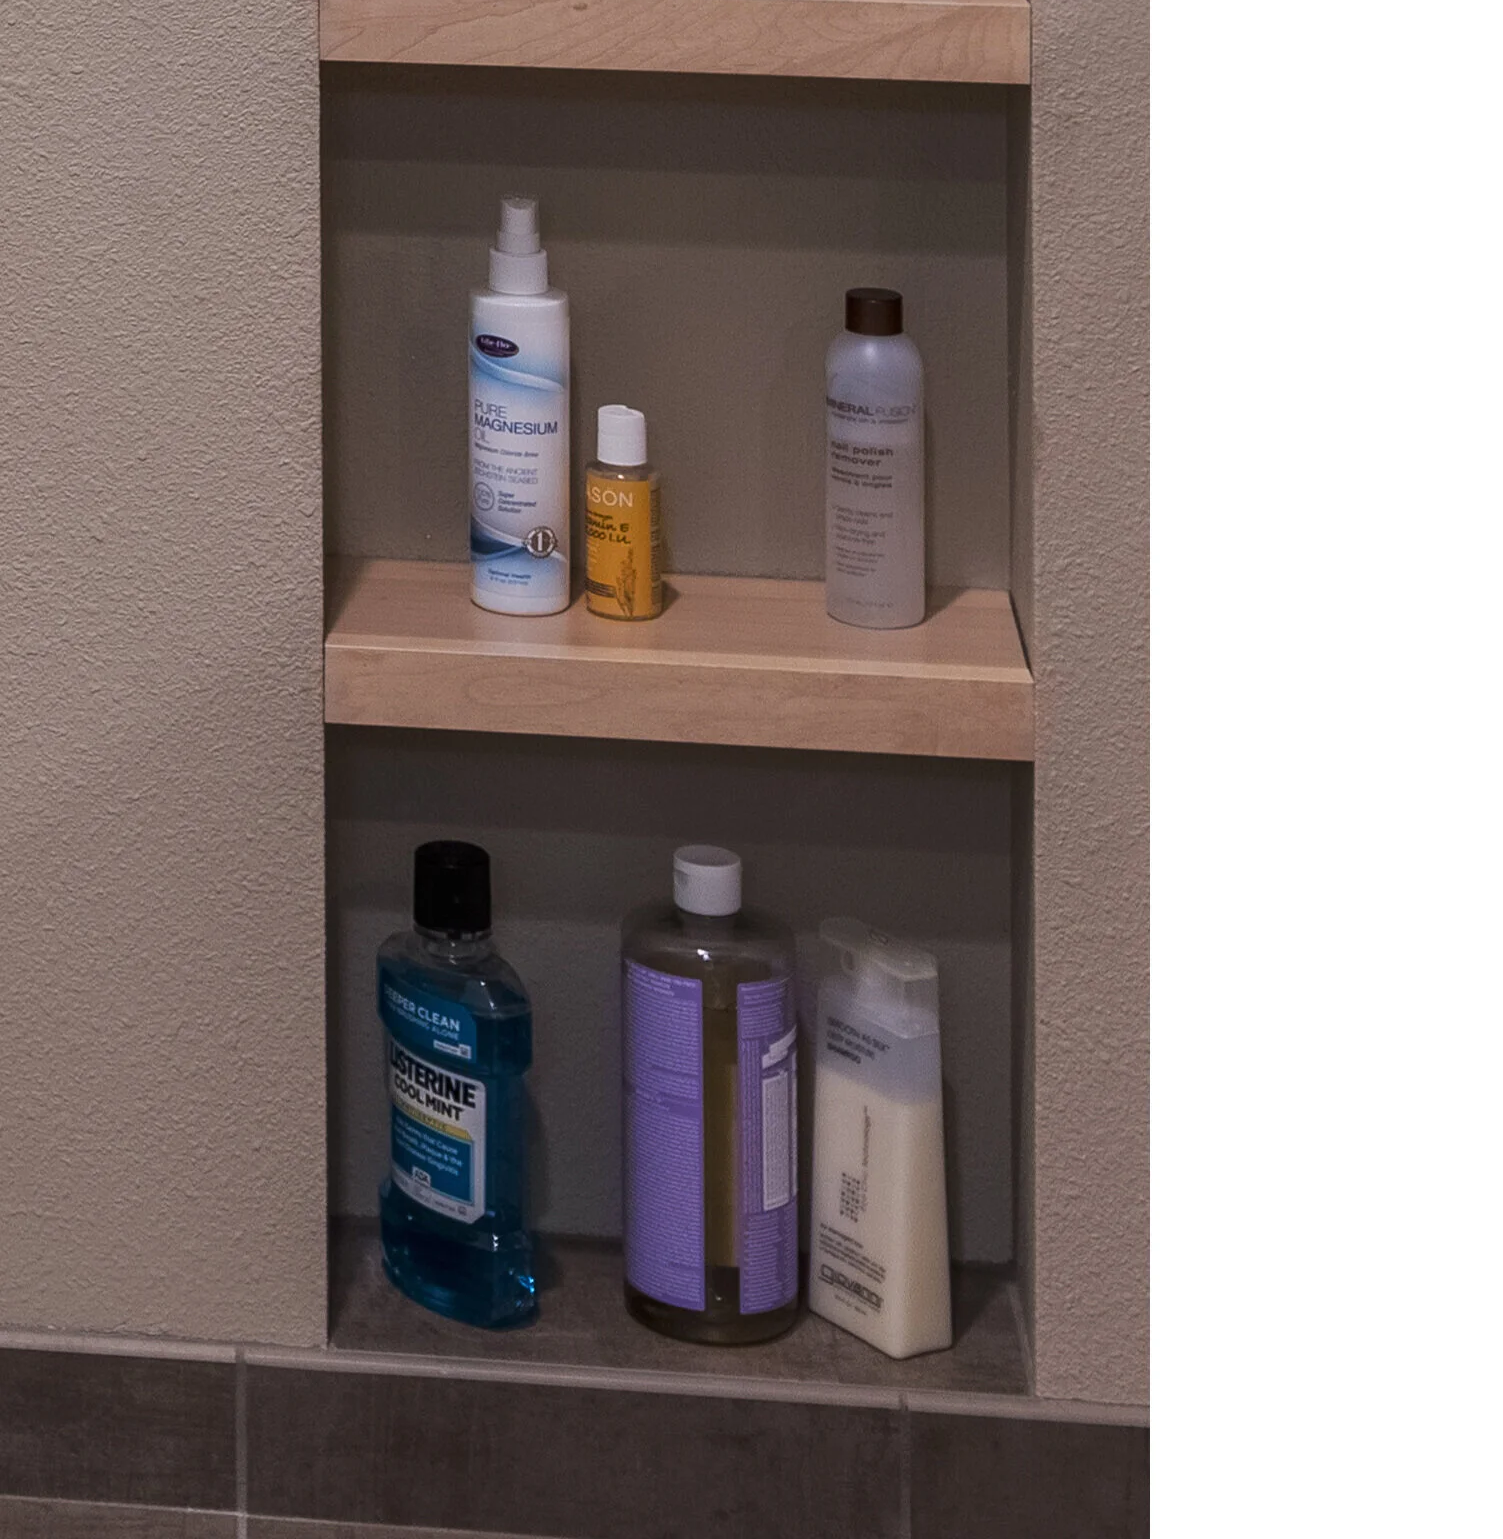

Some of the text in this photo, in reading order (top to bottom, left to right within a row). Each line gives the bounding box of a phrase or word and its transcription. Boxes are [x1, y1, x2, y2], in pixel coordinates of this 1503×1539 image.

[474, 398, 508, 421] PURE
[474, 413, 558, 436] MAGNESIUM
[831, 451, 882, 467] remover
[852, 446, 894, 457] polish
[417, 1006, 461, 1033] CLEAN
[394, 1075, 465, 1122] COOL MINT
